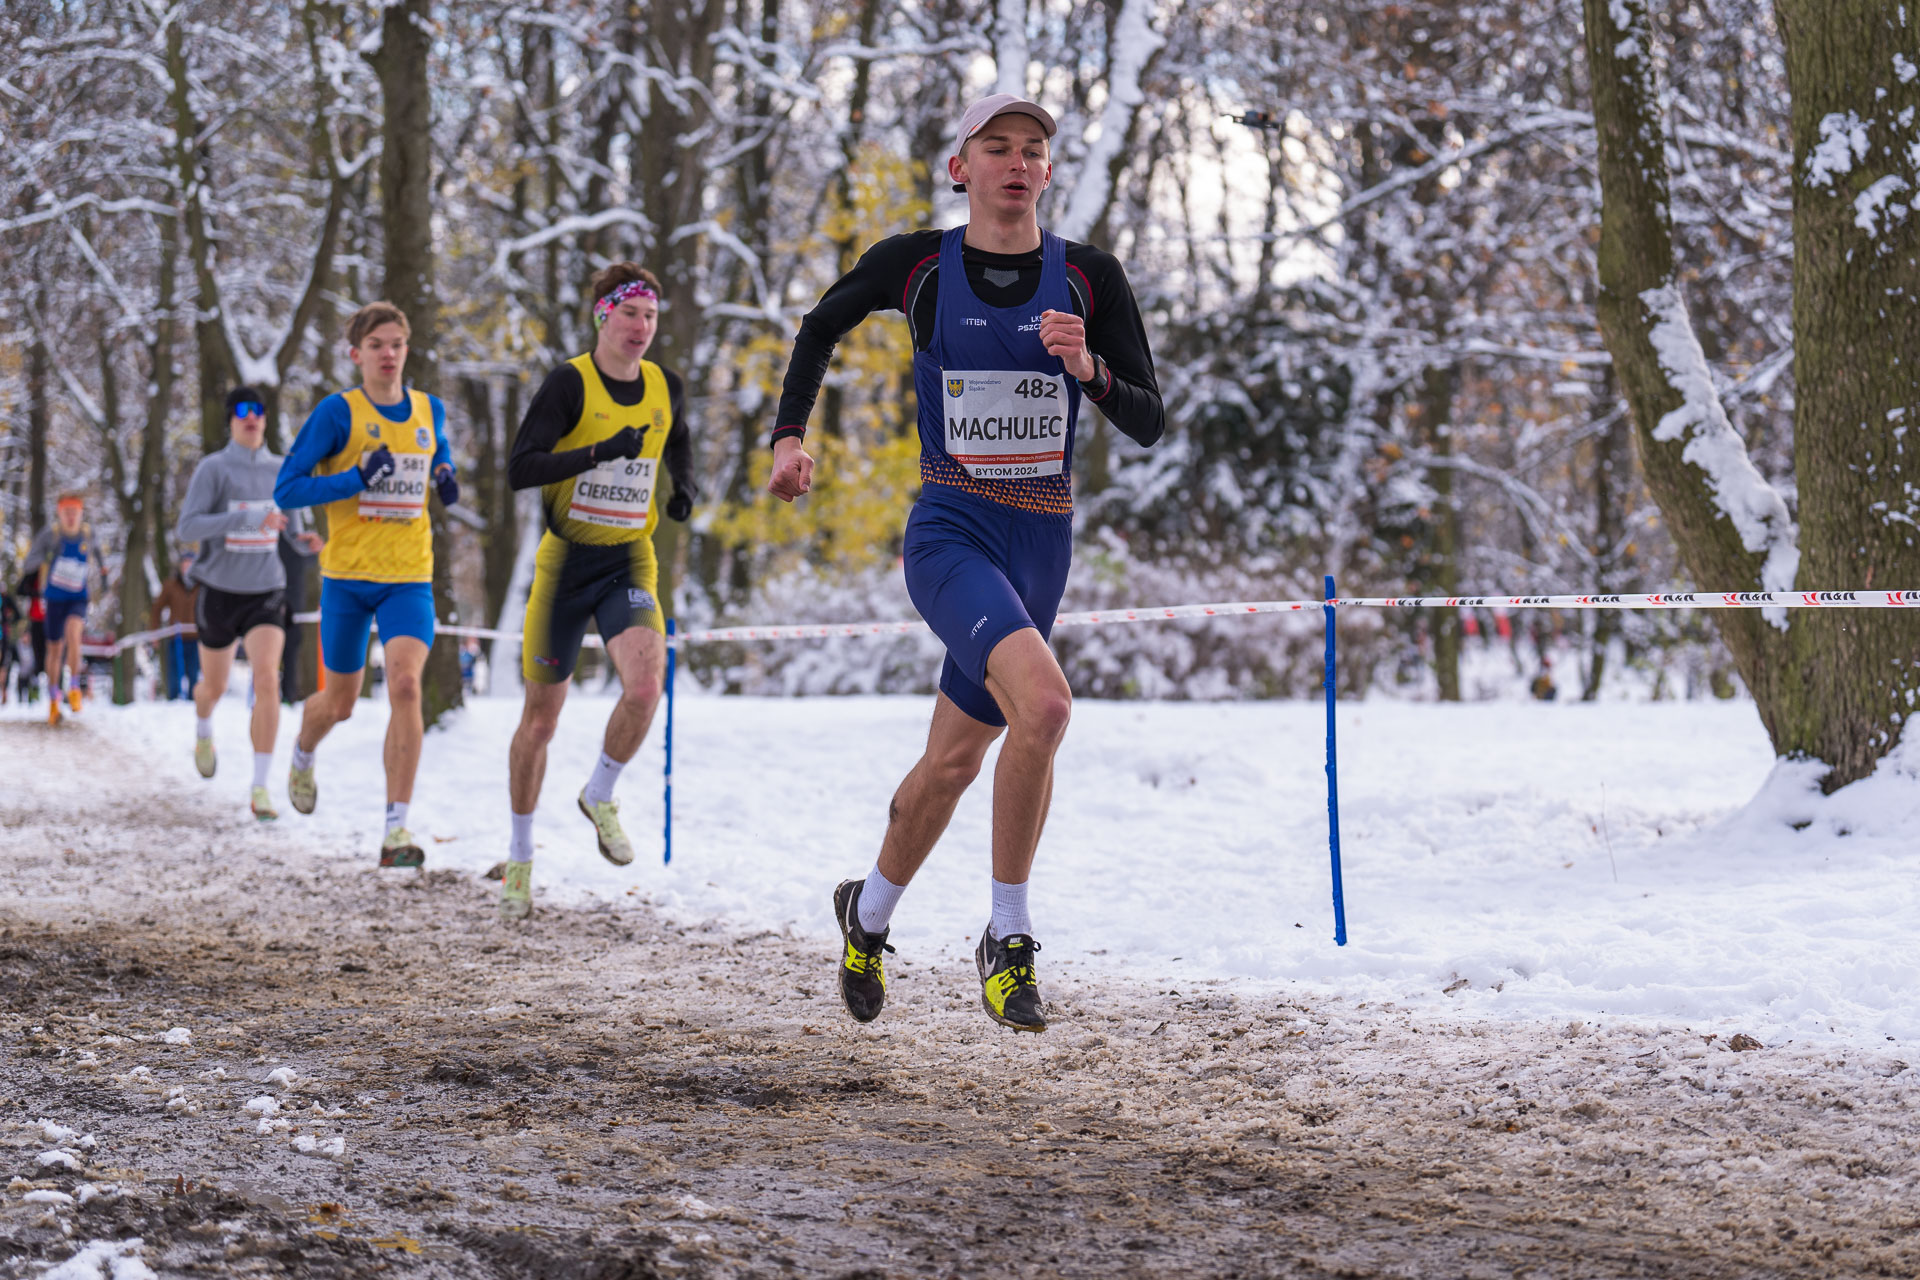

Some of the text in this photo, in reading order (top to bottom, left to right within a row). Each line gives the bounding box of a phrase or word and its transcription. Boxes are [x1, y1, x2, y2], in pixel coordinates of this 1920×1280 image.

[1014, 378, 1058, 400] 482
[949, 415, 1063, 441] MACHULEC
[402, 457, 424, 473] 581
[625, 462, 649, 477] 671
[975, 466, 1038, 476] BYTOM 2024
[366, 478, 424, 496] RUDŁO
[578, 481, 649, 503] CIERESZKO
